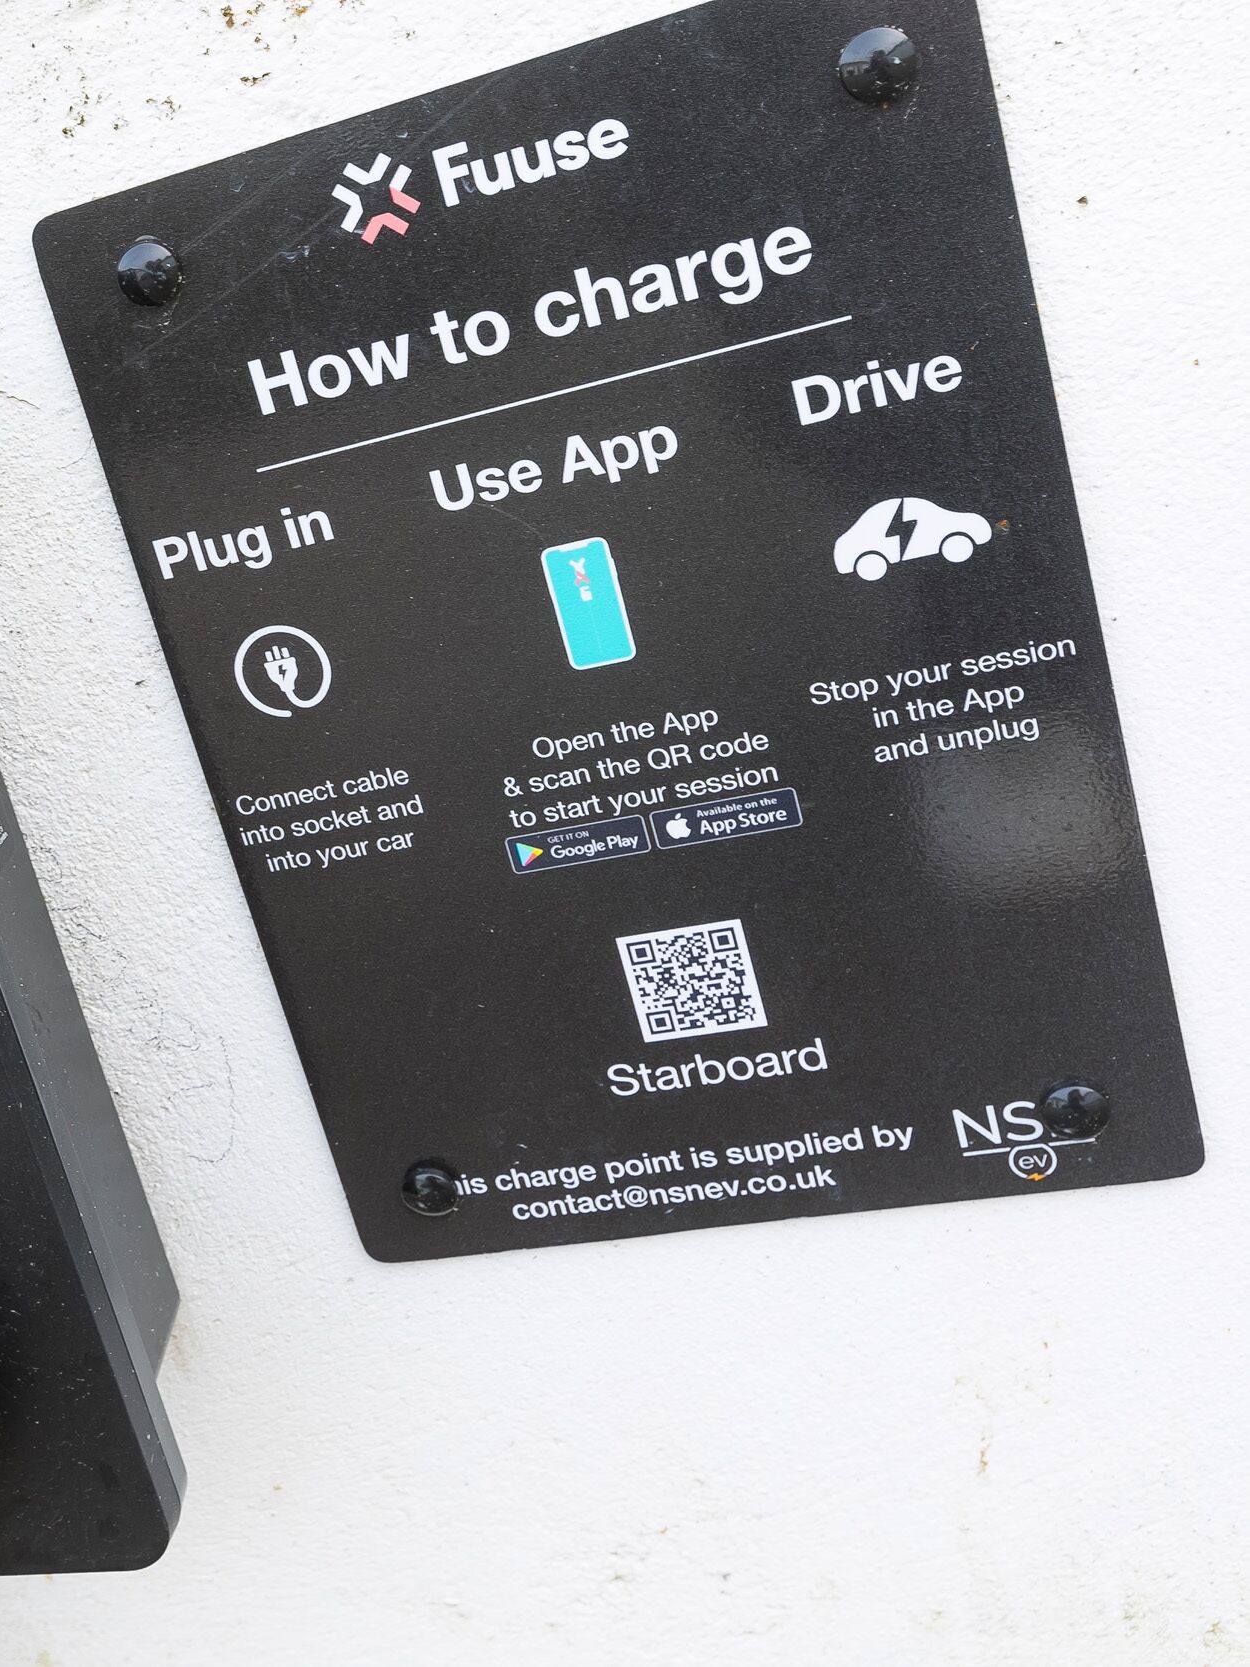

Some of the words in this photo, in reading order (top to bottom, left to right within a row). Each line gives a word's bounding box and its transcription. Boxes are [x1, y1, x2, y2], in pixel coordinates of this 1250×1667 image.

[431, 118, 630, 208] Fuuse
[246, 333, 410, 416] How
[429, 309, 511, 365] to
[533, 226, 813, 338] charge
[790, 355, 963, 427] Drive
[428, 459, 543, 512] Use
[561, 425, 679, 484] App
[151, 525, 273, 580] Plug
[279, 506, 335, 549] in
[809, 678, 879, 705] Stop
[885, 662, 952, 697] your
[960, 639, 1077, 676] session
[532, 731, 605, 761] Open
[609, 721, 655, 744] the
[662, 709, 719, 736] App
[871, 706, 900, 729] in
[905, 698, 955, 722] the
[963, 685, 1025, 714] App
[503, 776, 525, 798] &
[528, 767, 592, 793] scan
[595, 757, 641, 780] the
[646, 743, 693, 770] QR
[699, 731, 770, 761] code
[873, 732, 930, 763] and
[936, 717, 1040, 751] unplug
[235, 779, 338, 816] Connect
[342, 767, 410, 795] cable
[239, 824, 285, 847] into
[290, 805, 372, 837] socket
[376, 793, 424, 821] and
[508, 808, 537, 829] to
[542, 794, 604, 823] start
[606, 787, 667, 817] your
[672, 766, 779, 799] session
[696, 803, 742, 818] Available
[743, 801, 758, 810] on
[759, 797, 778, 807] the
[546, 834, 564, 844] GET
[574, 830, 590, 839] ON
[550, 838, 606, 859] Google
[605, 834, 639, 850] Play
[700, 818, 737, 836] App
[737, 809, 788, 828] Store
[265, 850, 312, 873] into
[315, 841, 370, 869] your
[376, 831, 414, 853] car
[606, 1037, 829, 1097] Starboard
[494, 1164, 597, 1192] charge
[603, 1150, 685, 1185] point
[689, 1146, 719, 1169] is
[725, 1126, 865, 1166] supplied
[871, 1124, 914, 1151] by
[512, 1164, 837, 1221] contact@nsnev.co.uk
